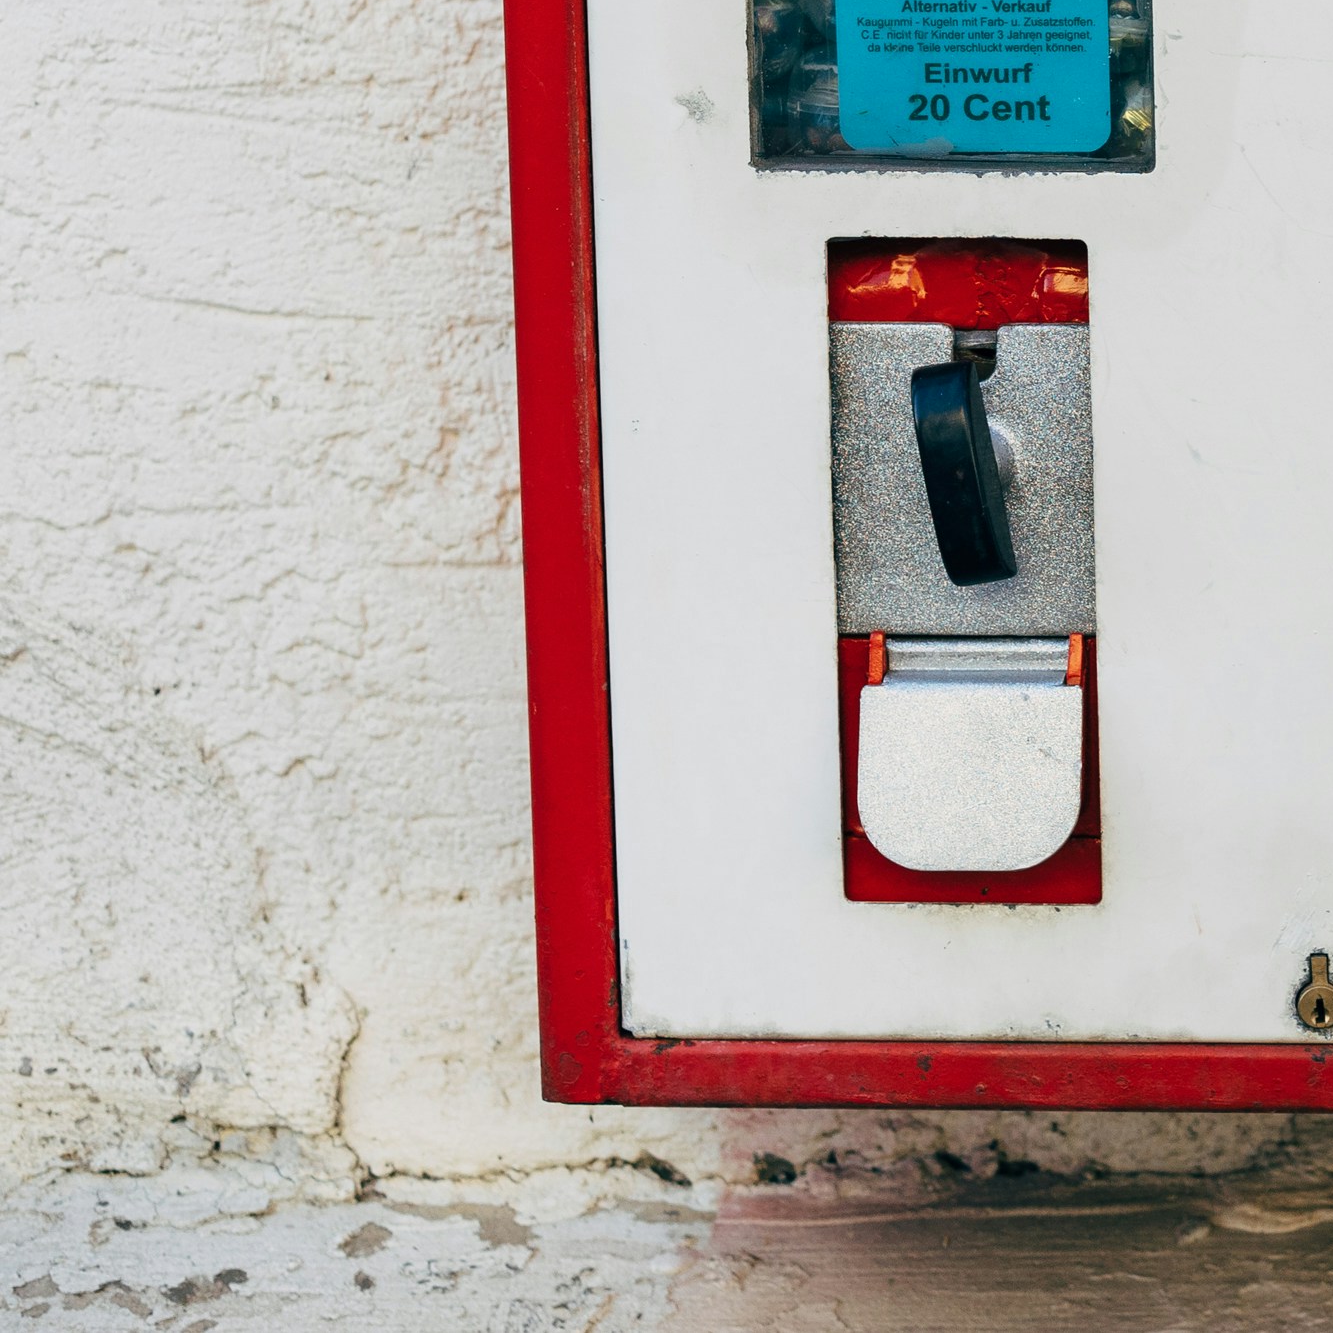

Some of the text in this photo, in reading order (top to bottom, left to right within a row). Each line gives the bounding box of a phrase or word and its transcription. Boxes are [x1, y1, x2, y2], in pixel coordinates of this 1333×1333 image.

[901, 0, 1052, 13] Alternativ Verkauf
[857, 17, 913, 29] Kaugummi
[922, 17, 959, 29] Kugeln
[961, 17, 978, 27] mit
[980, 17, 1008, 27] Farb-
[1023, 17, 1096, 27] Zusatzstoffen.
[887, 30, 912, 40] nicht
[914, 30, 929, 40] für
[931, 30, 965, 40] Kinder
[968, 31, 994, 40] unter
[997, 30, 1004, 40] 3
[1007, 30, 1042, 40] Jahren
[1045, 30, 1092, 42] geeignet,
[867, 43, 1087, 53] da kleine Teile verschluckt werden können.
[924, 63, 1033, 84] Einwurf
[908, 94, 1051, 122] 20 Cent
